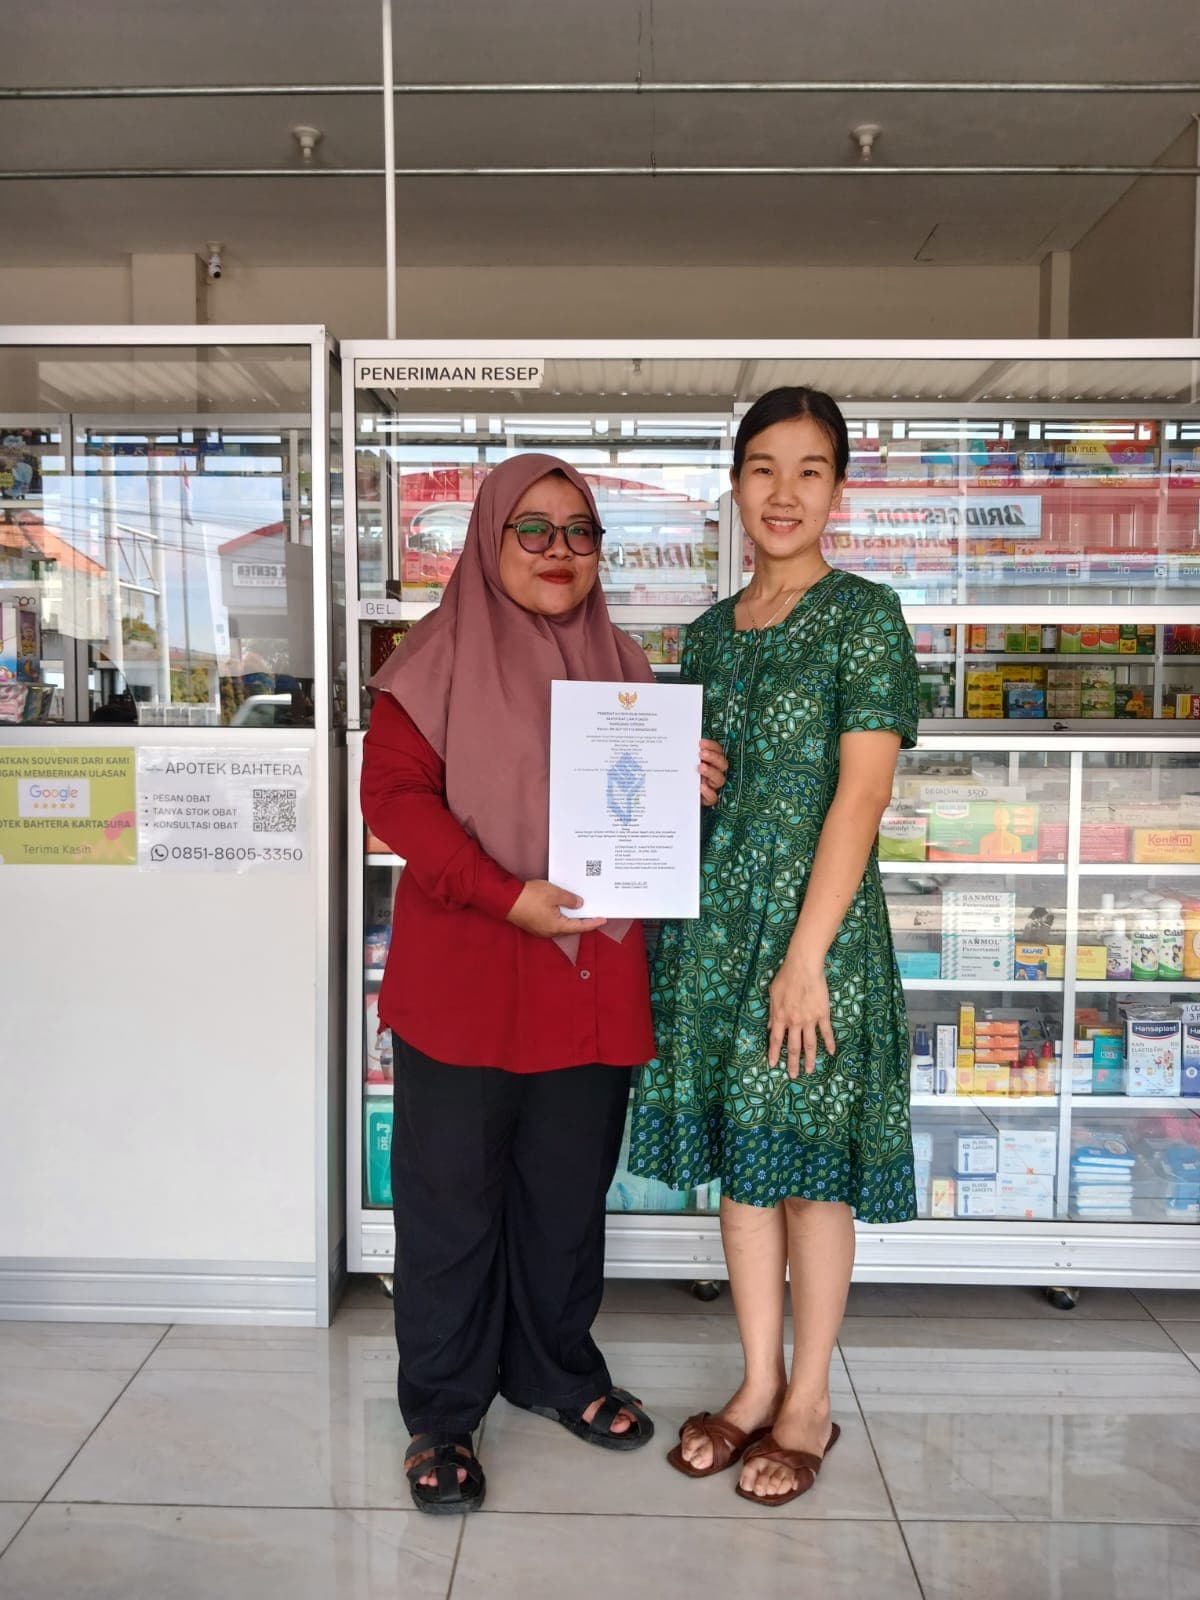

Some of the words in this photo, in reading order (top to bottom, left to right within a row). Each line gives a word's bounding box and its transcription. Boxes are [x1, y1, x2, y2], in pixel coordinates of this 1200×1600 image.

[360, 367, 476, 381] PENERIMAAN
[481, 368, 539, 381] RESEP
[365, 602, 396, 615] BEL
[31, 756, 79, 765] SOUVENIR
[81, 756, 104, 765] DARI
[105, 757, 130, 766] KAMI
[24, 770, 86, 778] MEMBERIKAN
[89, 770, 126, 778] ULASAN
[165, 762, 227, 775] APOTEK
[231, 763, 303, 776] BAHTERA
[29, 784, 79, 802] Google
[153, 793, 184, 803] PESAN
[186, 794, 211, 803] OBAT
[153, 807, 183, 816] TANYA
[186, 807, 210, 817] STOK
[212, 807, 237, 817] OBAT
[23, 820, 71, 829] BAHTERA
[72, 820, 131, 829] KARTASURA
[153, 821, 211, 830] KONSULTASI
[213, 821, 238, 830] OBAT
[23, 844, 59, 855] Terima
[62, 844, 92, 855] Kasih
[172, 846, 303, 861] 0851-8605-3350
[962, 938, 1000, 946] SANMOL
[1135, 1024, 1177, 1034] Hansaplast
